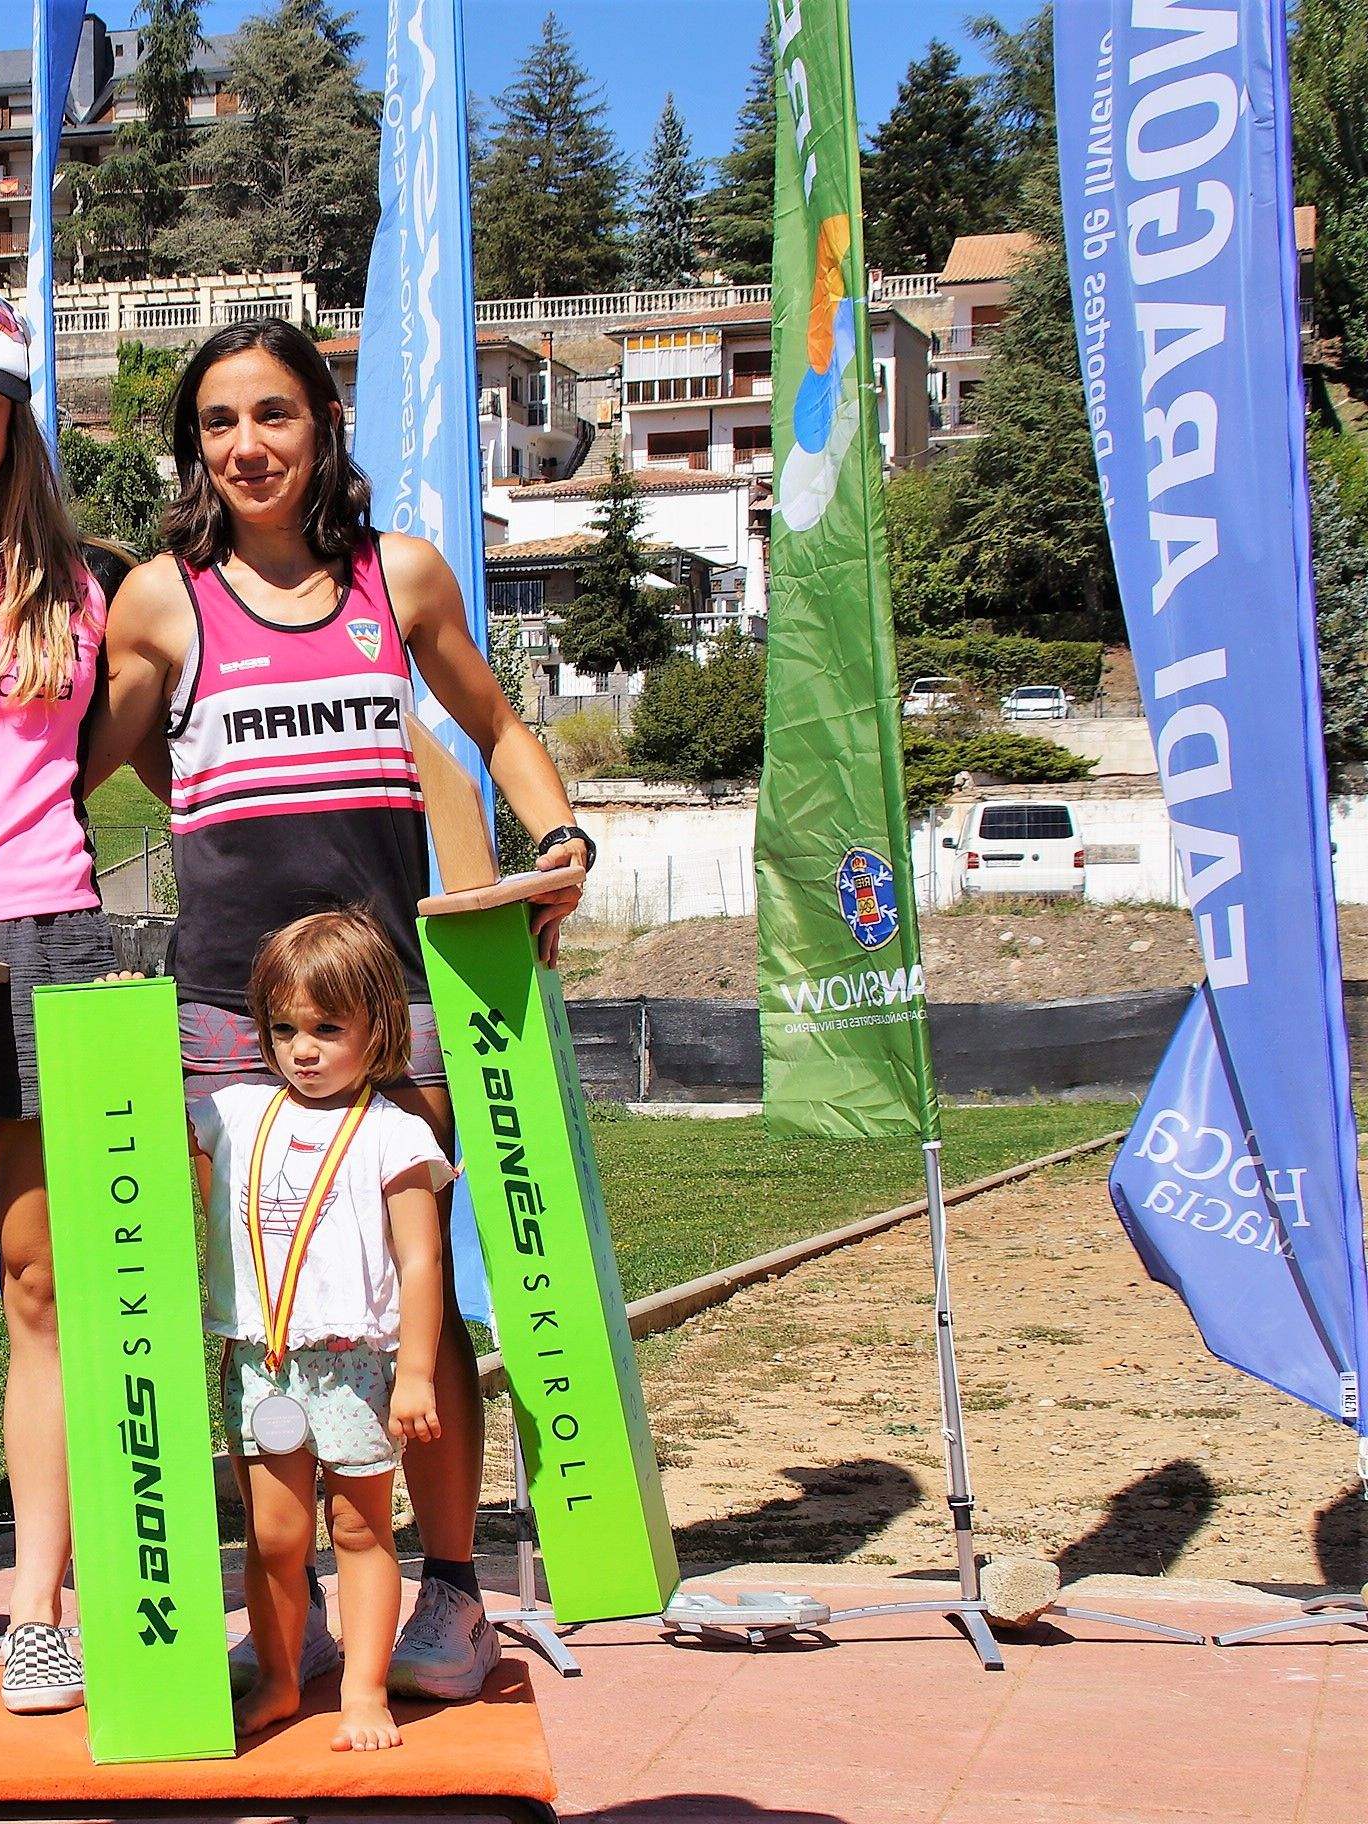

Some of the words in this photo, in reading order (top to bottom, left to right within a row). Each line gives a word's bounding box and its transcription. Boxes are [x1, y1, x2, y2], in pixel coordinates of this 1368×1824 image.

[104, 1099, 151, 1355] SKIROLL
[479, 1065, 546, 1259] BONES
[522, 1272, 594, 1513] SKIROLL
[116, 1373, 171, 1585] BONES
